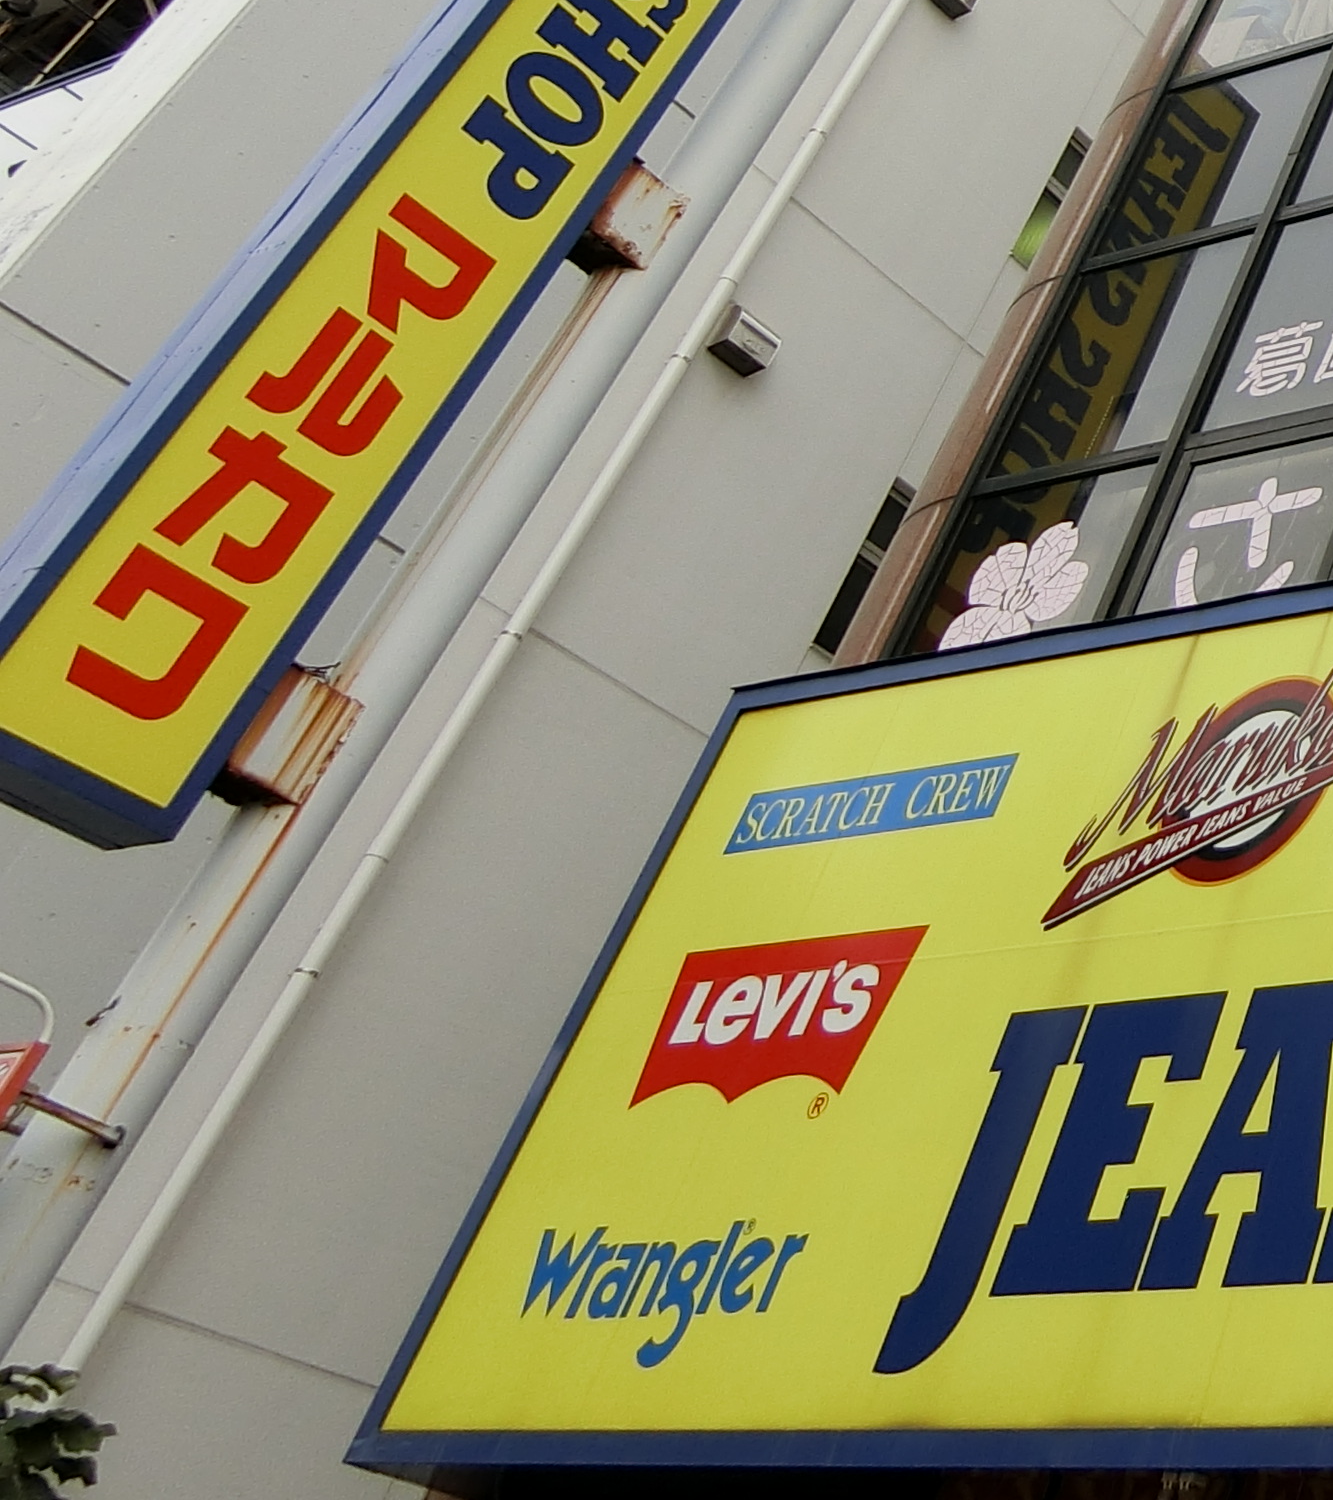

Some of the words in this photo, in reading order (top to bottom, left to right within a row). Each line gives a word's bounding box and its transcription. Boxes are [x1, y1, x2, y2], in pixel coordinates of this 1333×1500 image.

[66, 193, 497, 720] マルカワ
[736, 782, 896, 845] SCRATCH
[905, 764, 1011, 820] CREW
[1074, 854, 1133, 899] JEANS
[1132, 825, 1198, 871] POWER
[1195, 800, 1251, 845] JEANS
[1253, 776, 1308, 814] VALUE
[520, 1220, 809, 1368] Wrangler
